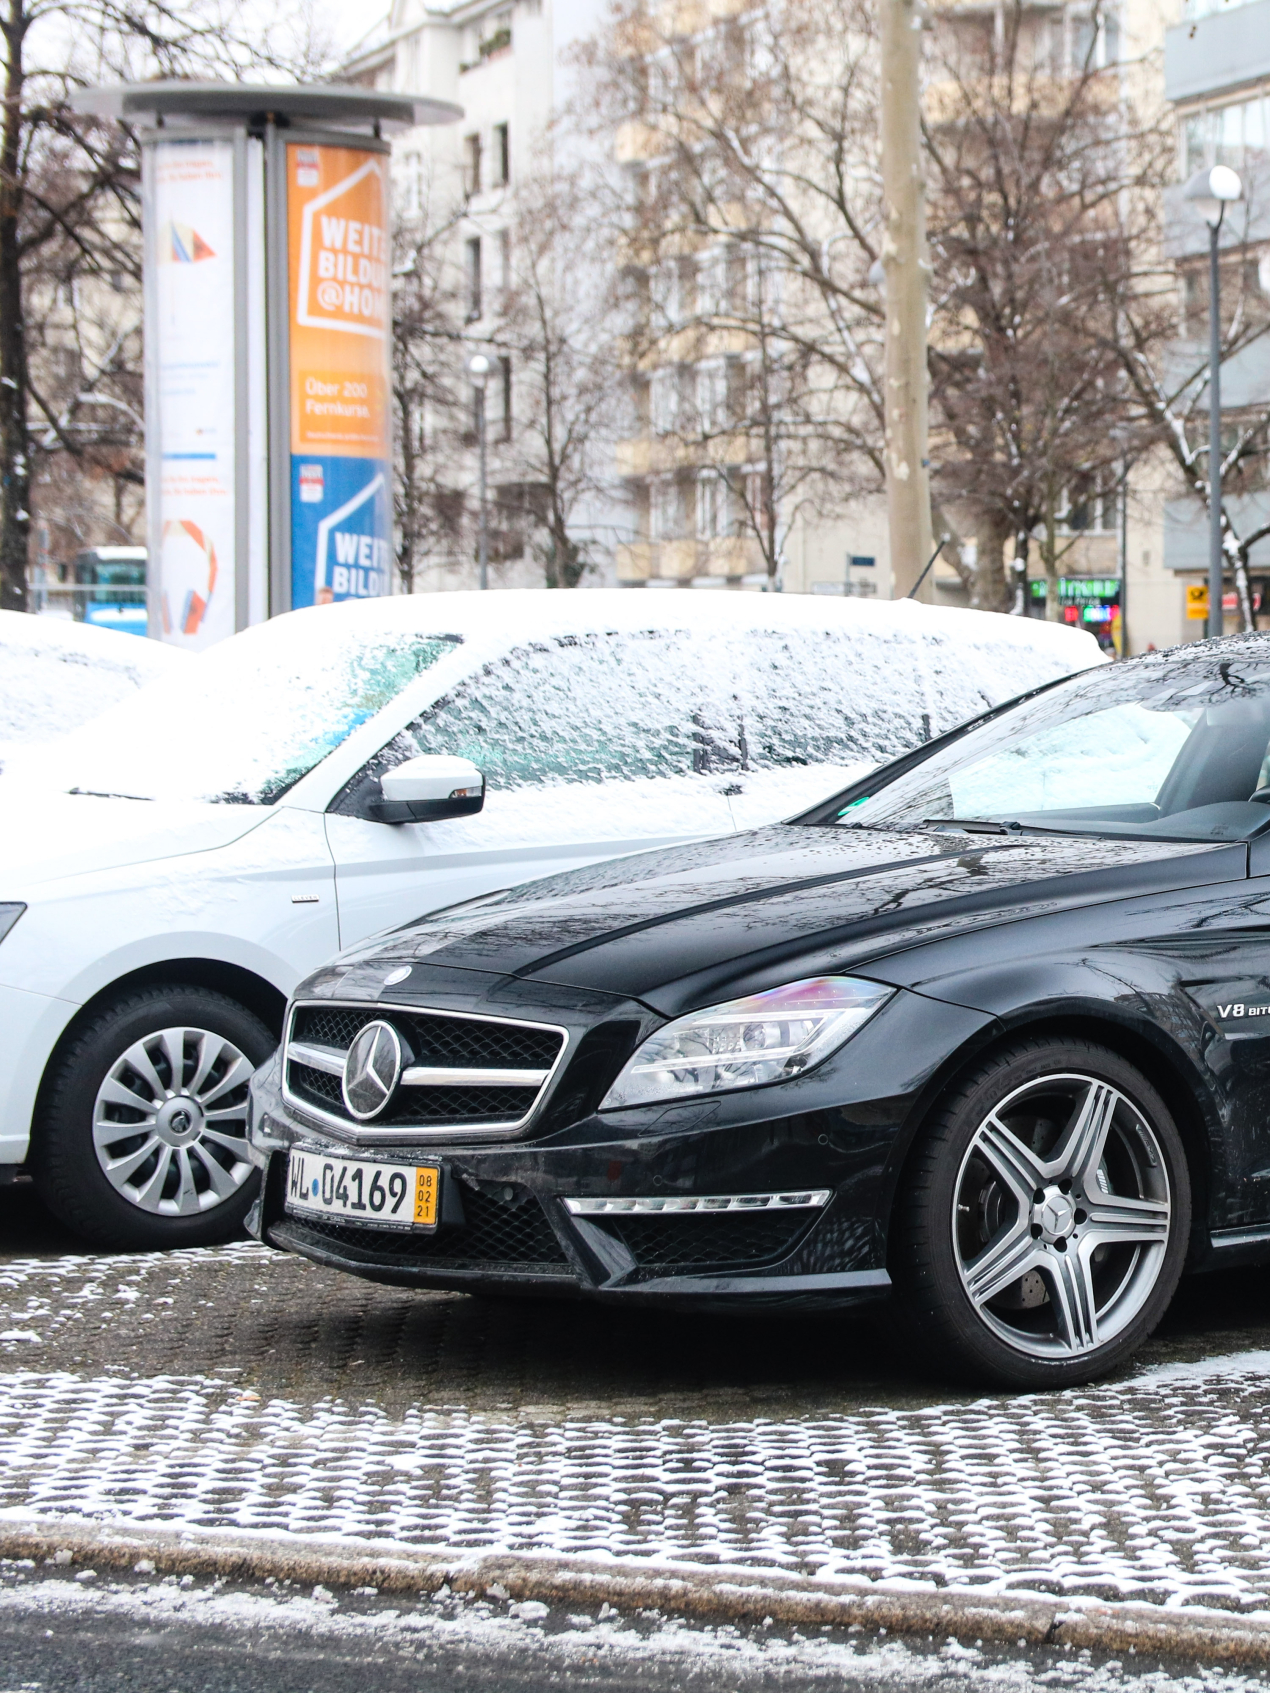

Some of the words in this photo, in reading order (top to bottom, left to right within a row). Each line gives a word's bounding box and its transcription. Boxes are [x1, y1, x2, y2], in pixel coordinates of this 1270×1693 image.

[343, 381, 368, 398] 200
[1217, 1003, 1245, 1018] V8
[290, 1155, 309, 1201] WL
[321, 1163, 407, 1214] 04169
[419, 1174, 432, 1187] 08
[418, 1189, 431, 1202] 02
[417, 1205, 429, 1217] 21
